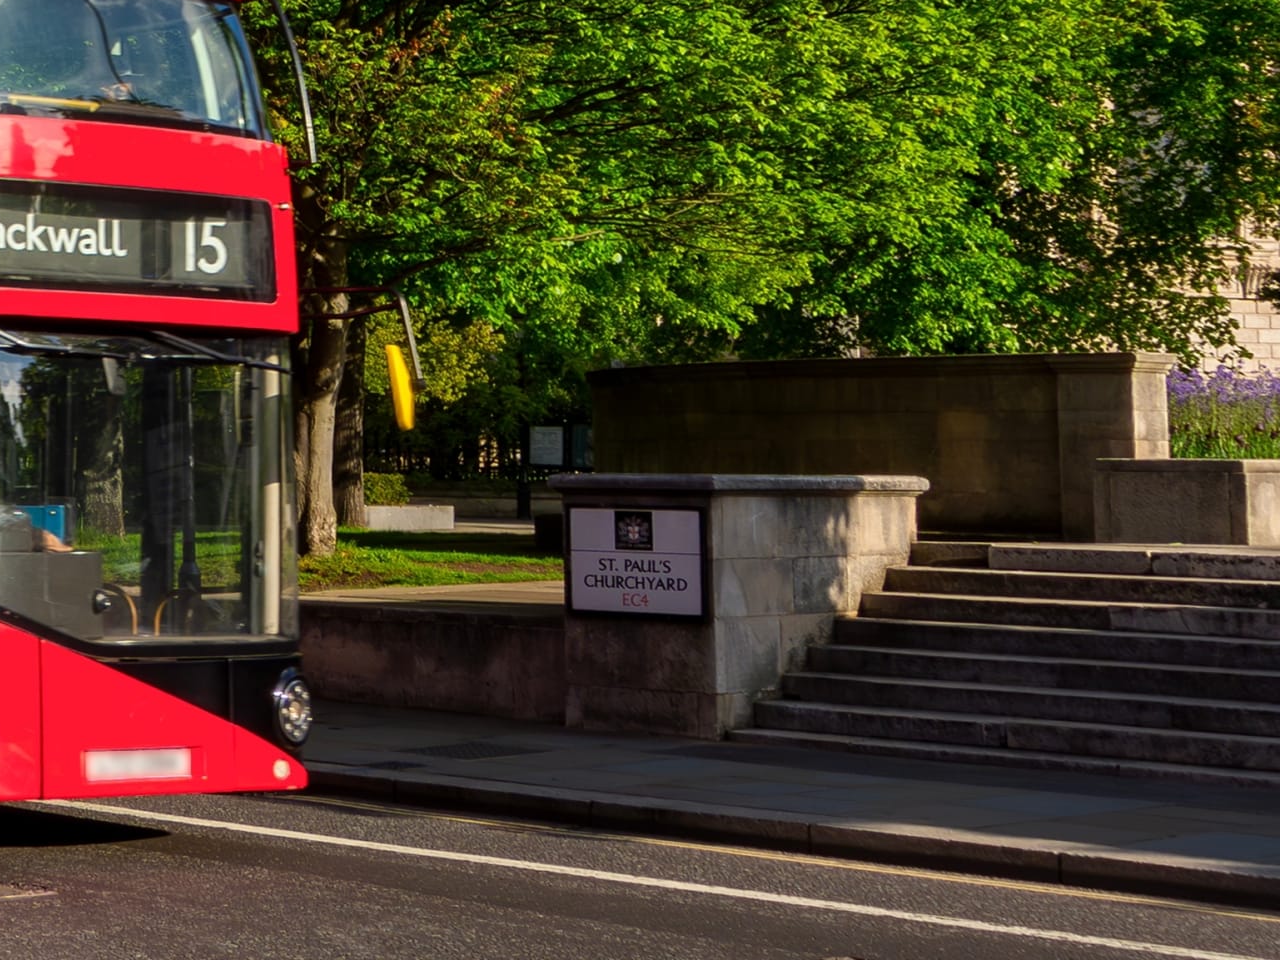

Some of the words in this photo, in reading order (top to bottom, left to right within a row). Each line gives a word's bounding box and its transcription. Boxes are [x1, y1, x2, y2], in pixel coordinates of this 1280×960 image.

[184, 216, 228, 275] 15
[598, 558, 619, 572] ST.
[624, 559, 672, 574] PAUL'S
[584, 574, 688, 591] CHURCHYARD
[622, 593, 649, 607] EC4
